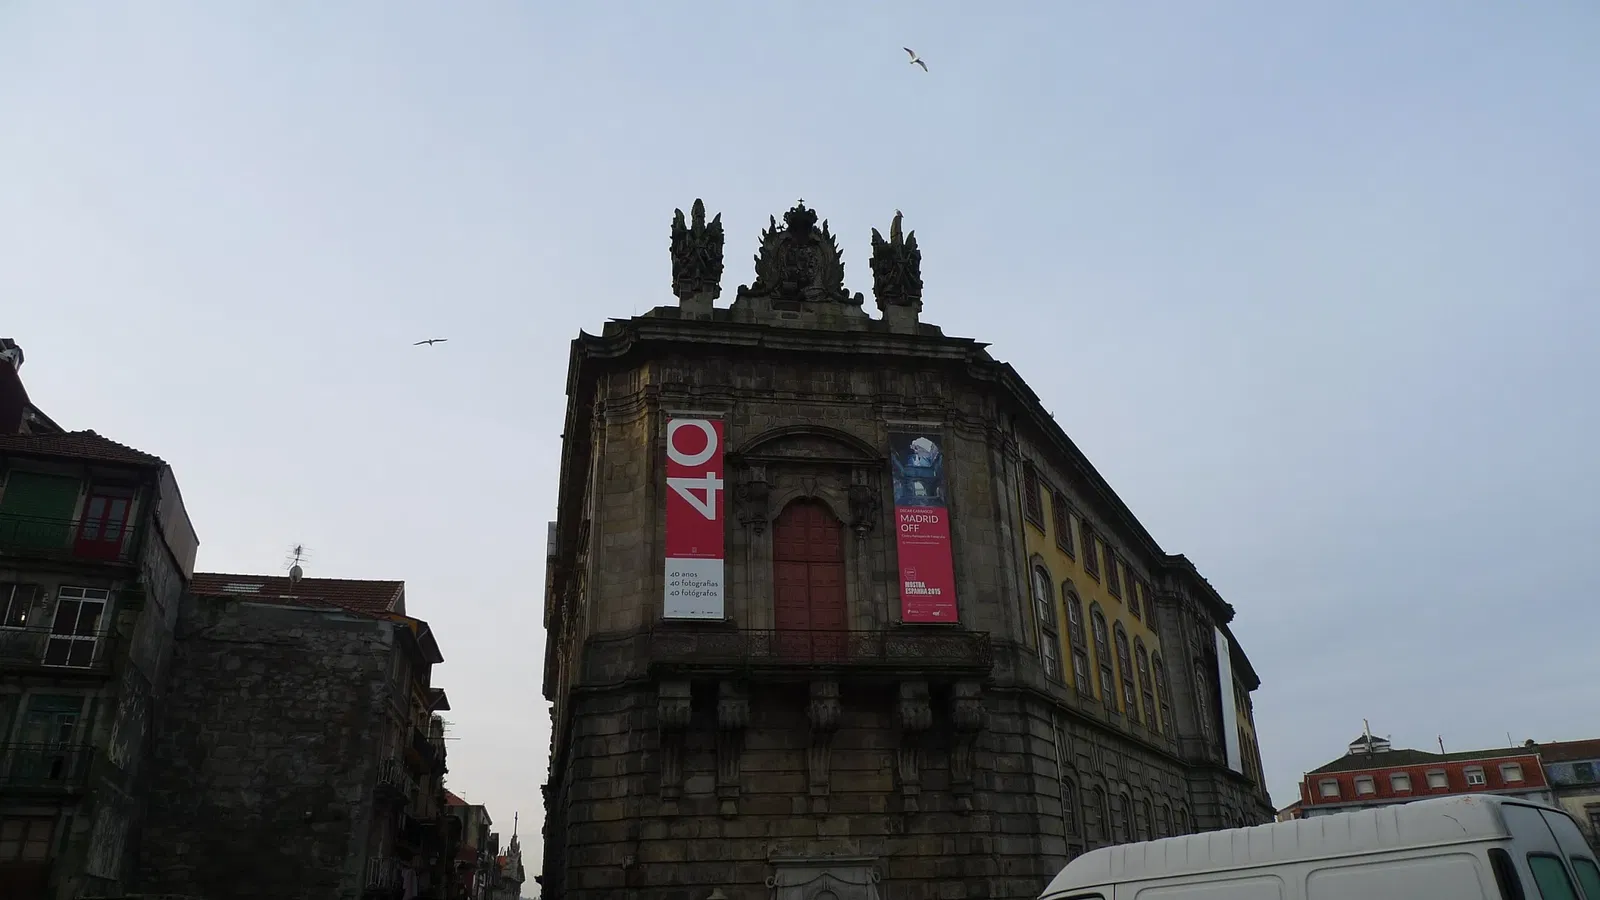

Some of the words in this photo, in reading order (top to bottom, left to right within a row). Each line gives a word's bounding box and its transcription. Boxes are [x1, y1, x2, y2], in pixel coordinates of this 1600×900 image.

[667, 419, 723, 520] 40
[900, 514, 939, 523] MADRID
[901, 524, 920, 532] OFF
[681, 579, 718, 588] fotografias
[681, 589, 718, 598] fotógrafos
